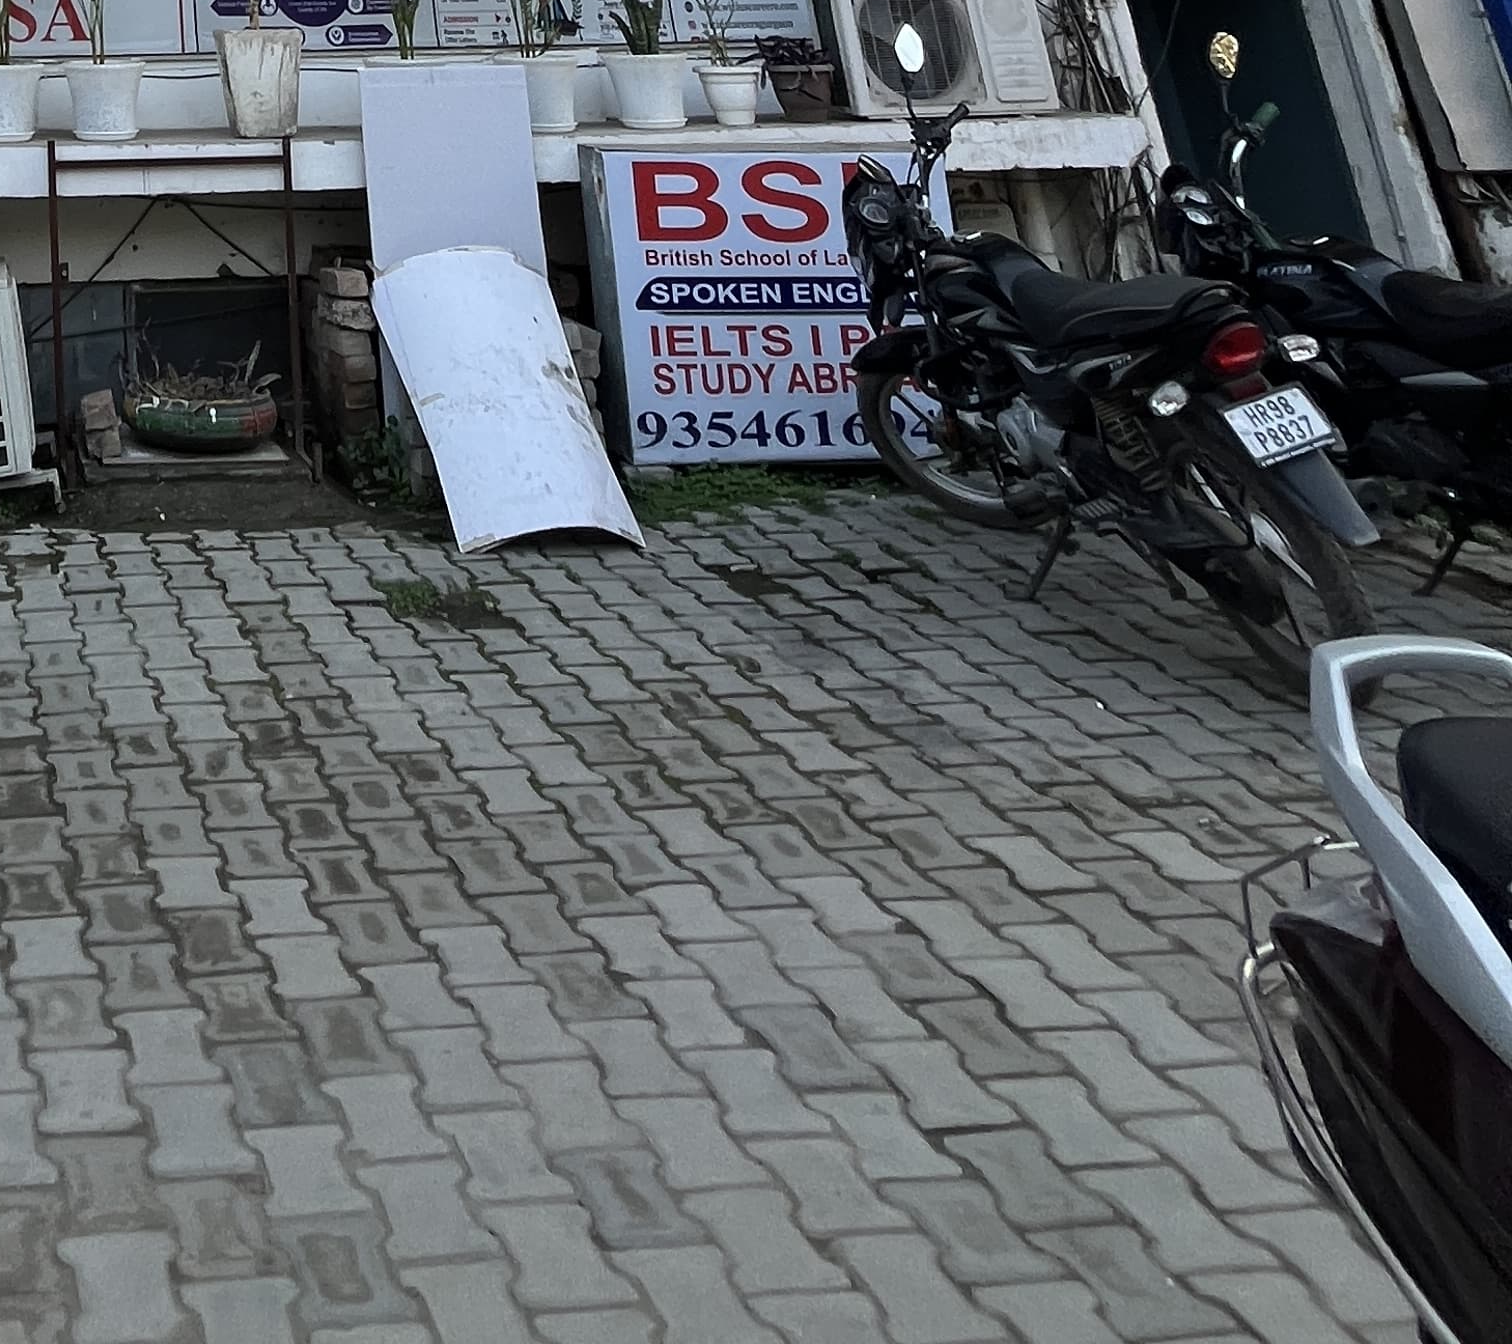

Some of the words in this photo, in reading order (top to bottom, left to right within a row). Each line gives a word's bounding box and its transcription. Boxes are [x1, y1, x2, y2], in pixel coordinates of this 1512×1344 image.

[645, 247, 713, 267] British
[719, 248, 792, 267] School
[649, 281, 782, 305] SPOKEN
[1243, 396, 1296, 428] HR98
[1253, 415, 1315, 453] P8837
